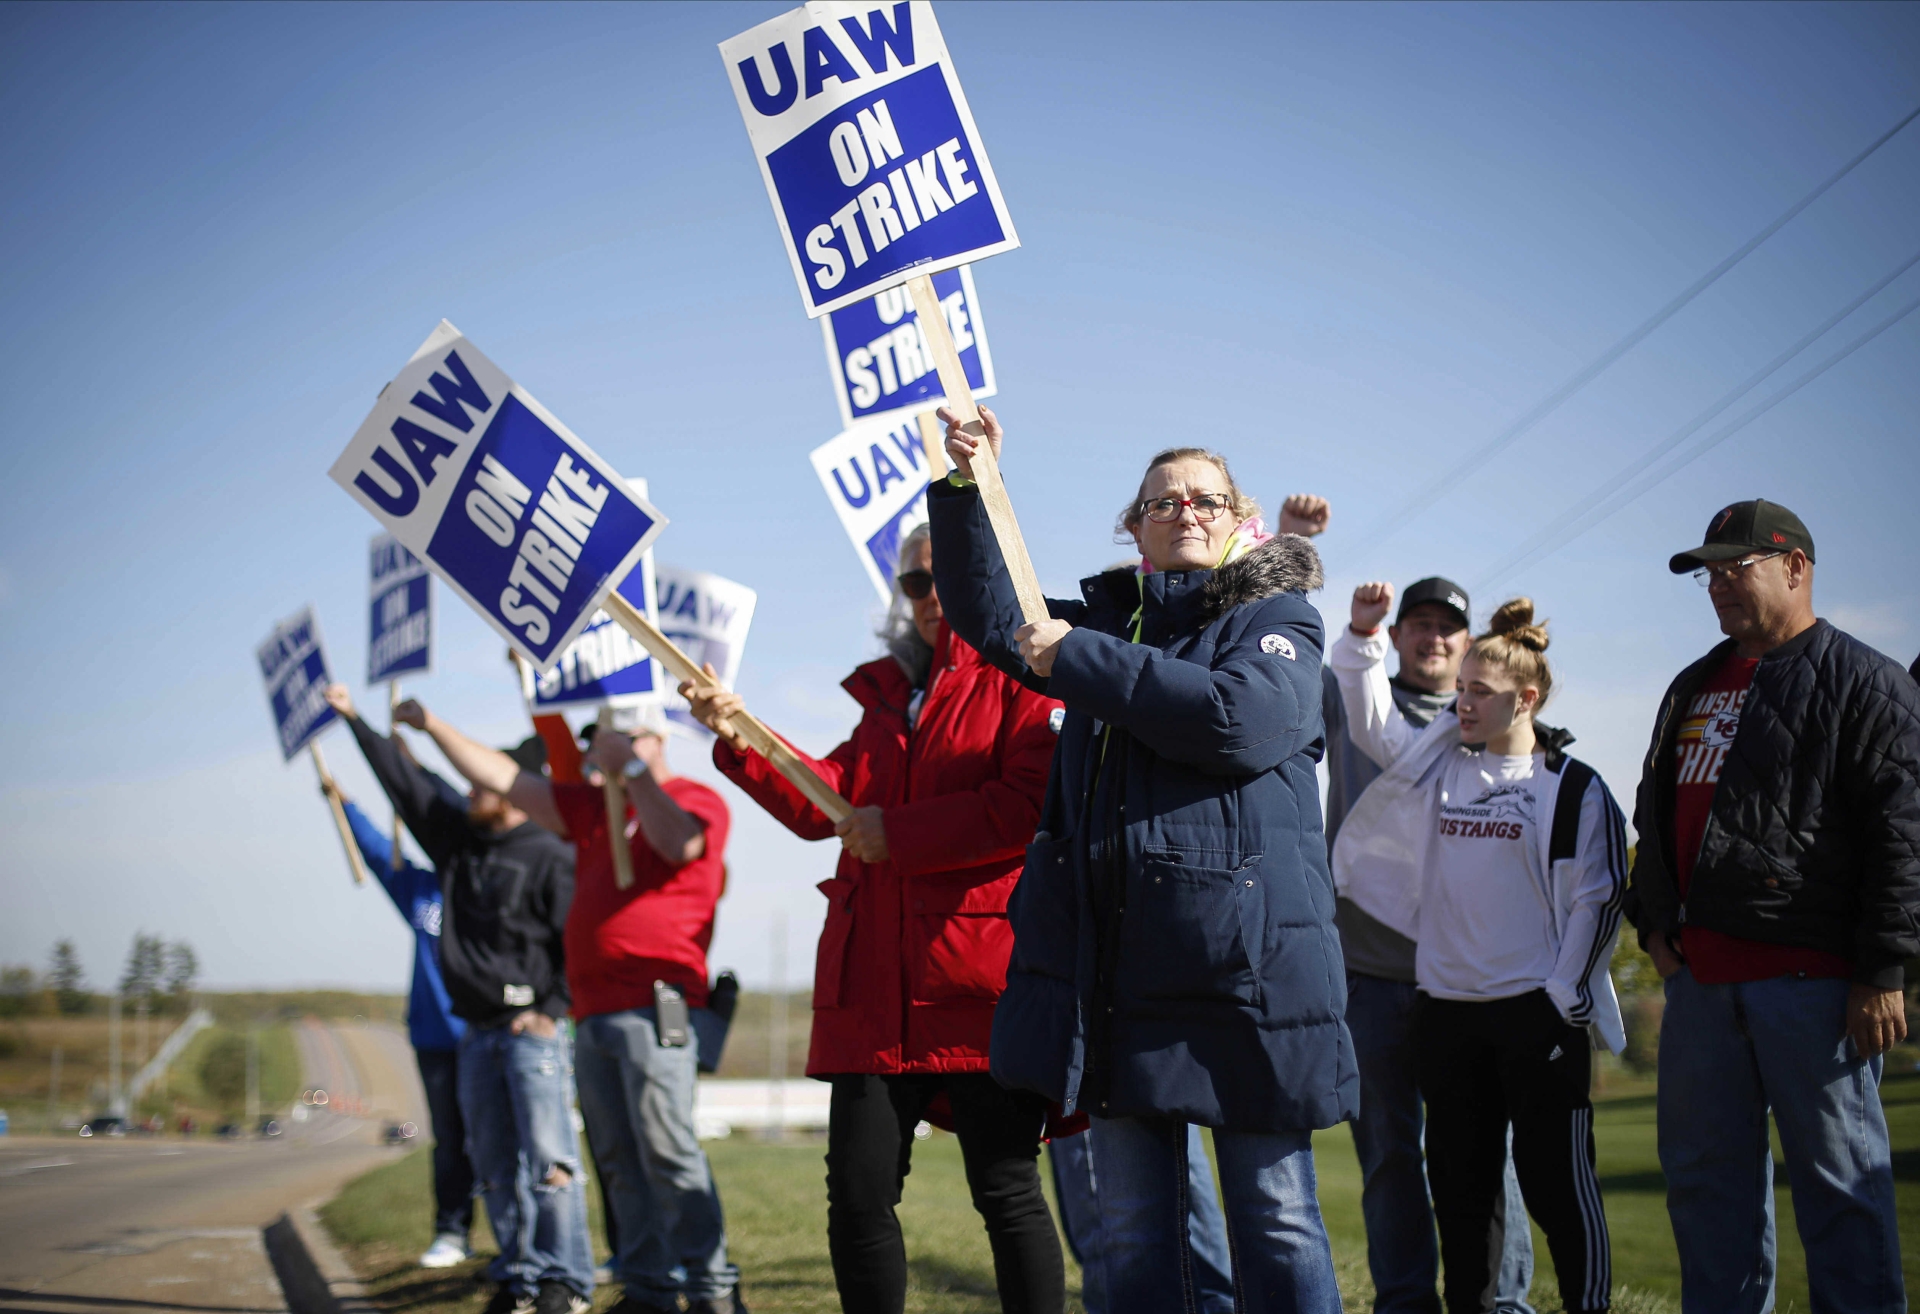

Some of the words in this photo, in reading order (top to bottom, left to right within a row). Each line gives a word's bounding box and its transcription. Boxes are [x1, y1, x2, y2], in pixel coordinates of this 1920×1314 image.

[737, 1, 916, 117] UAW
[828, 98, 905, 188] ON
[805, 136, 979, 291] STRIKE
[353, 348, 493, 519] UAW
[464, 452, 533, 548] ON
[499, 451, 611, 647] STRIKE
[1440, 818, 1524, 841] USTANGS
